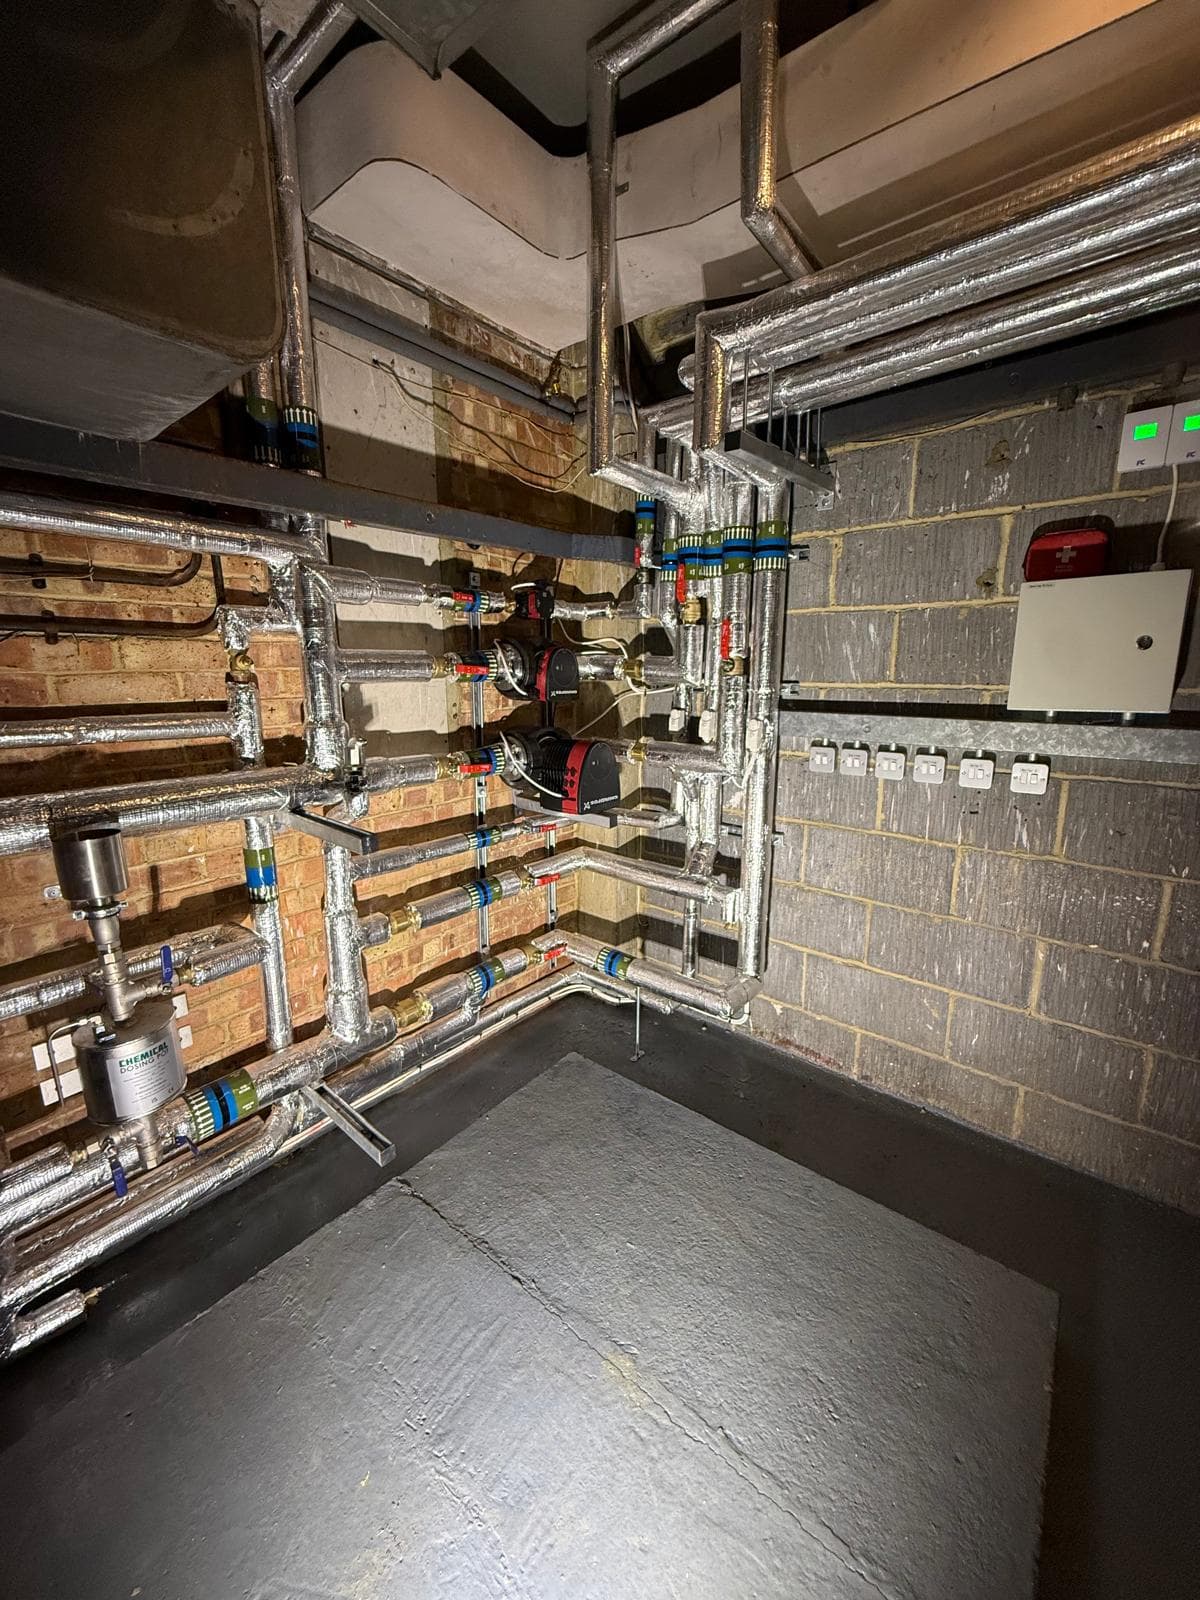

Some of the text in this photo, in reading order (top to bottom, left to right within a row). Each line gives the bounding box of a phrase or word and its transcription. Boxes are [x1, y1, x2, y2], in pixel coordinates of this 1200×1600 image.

[119, 1041, 169, 1067] CHEMICAL
[120, 1048, 169, 1074] DOSING POT
